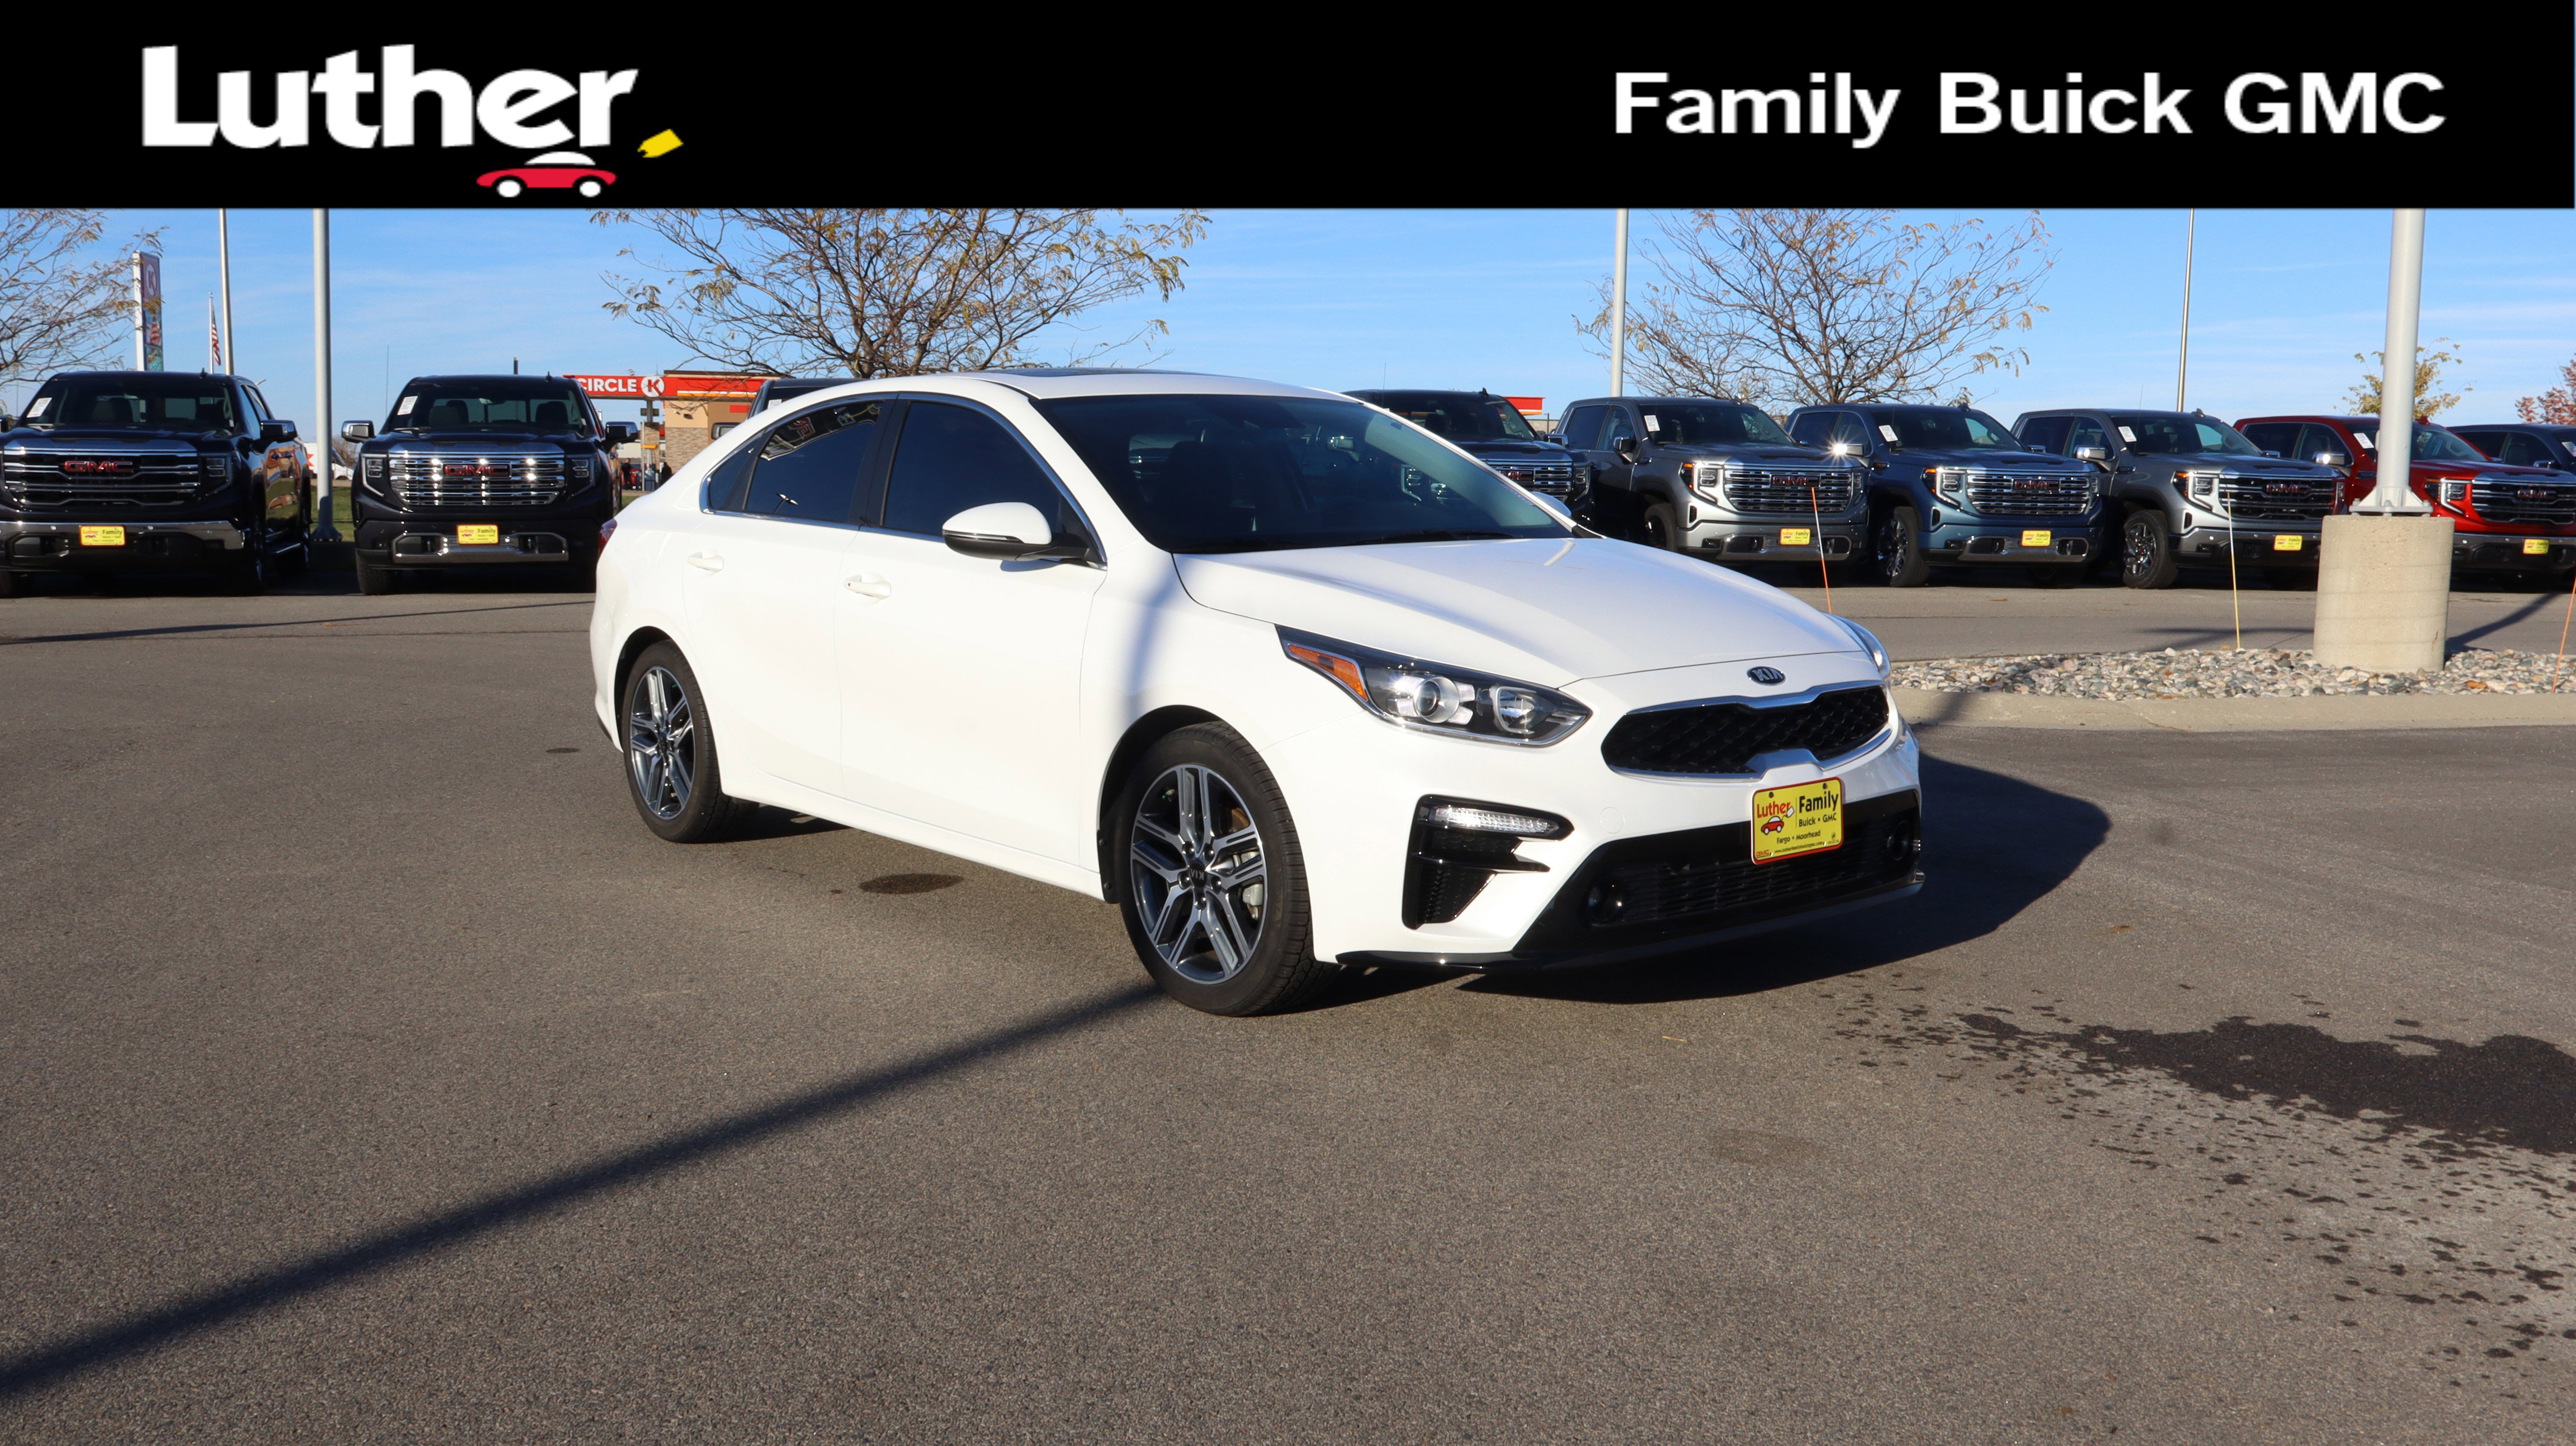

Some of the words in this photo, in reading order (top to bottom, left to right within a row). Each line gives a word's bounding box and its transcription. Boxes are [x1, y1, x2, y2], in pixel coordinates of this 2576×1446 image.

[576, 378, 637, 392] CIRCLE
[64, 461, 133, 472] GMC
[445, 465, 508, 476] GMC
[1772, 476, 1818, 486] GMC
[1752, 668, 1784, 681] KIA
[1799, 791, 1839, 813] Family
[1757, 801, 1791, 818] Luther
[1799, 817, 1816, 827] Buick
[1822, 813, 1837, 823] GMC
[1796, 830, 1821, 840] Moorhead
[1190, 868, 1204, 880] KIA
